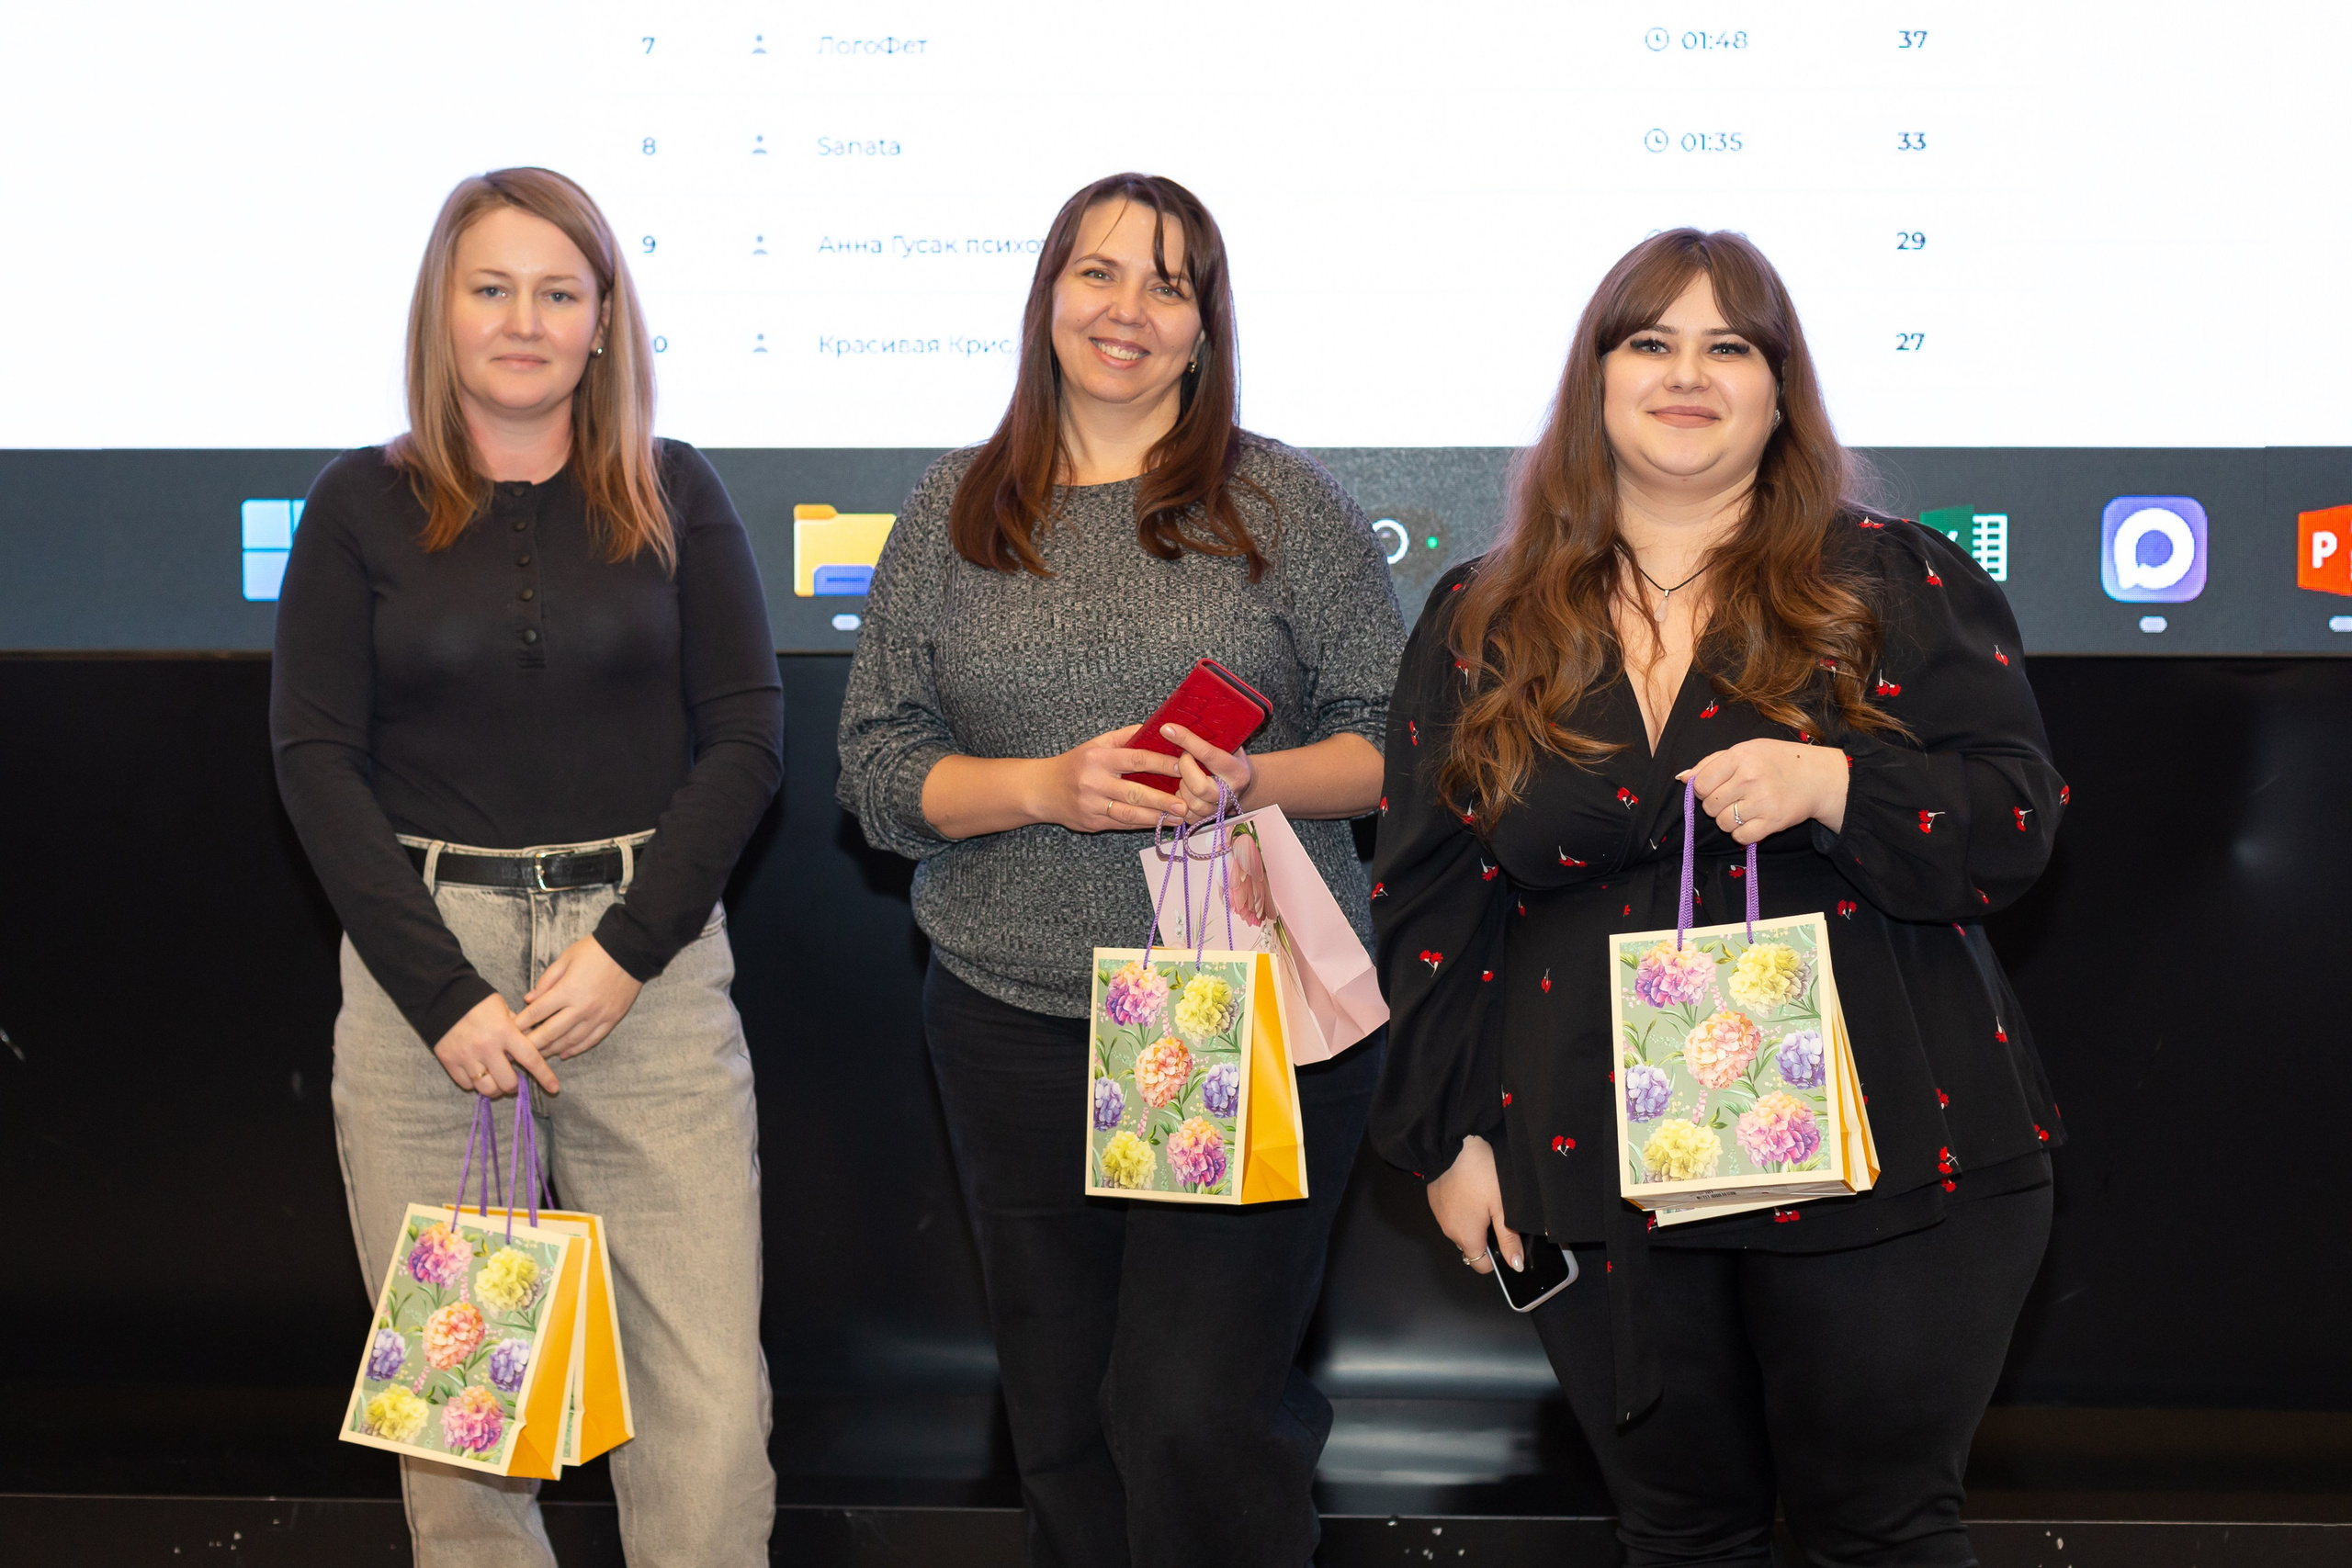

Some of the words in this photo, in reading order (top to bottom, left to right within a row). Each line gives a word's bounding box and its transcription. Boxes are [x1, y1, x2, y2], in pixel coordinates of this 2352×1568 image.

[641, 36, 657, 55] 7
[817, 35, 929, 56] ЛогоФет
[1680, 30, 1749, 51] 01:48
[1897, 29, 1929, 50] 37
[641, 136, 657, 156] 8
[817, 136, 902, 157] Sanata
[1680, 131, 1744, 152] 01:35
[1896, 131, 1928, 152] 33
[641, 234, 658, 254] 9
[817, 235, 883, 254] Анна
[892, 235, 958, 258] Гусак
[966, 238, 1045, 254] психо
[1895, 231, 1928, 251] 29
[653, 334, 669, 354] 0
[819, 335, 941, 358] Красивая
[949, 335, 1014, 358] Крис
[1895, 332, 1927, 352] 27
[2312, 531, 2338, 569] P
